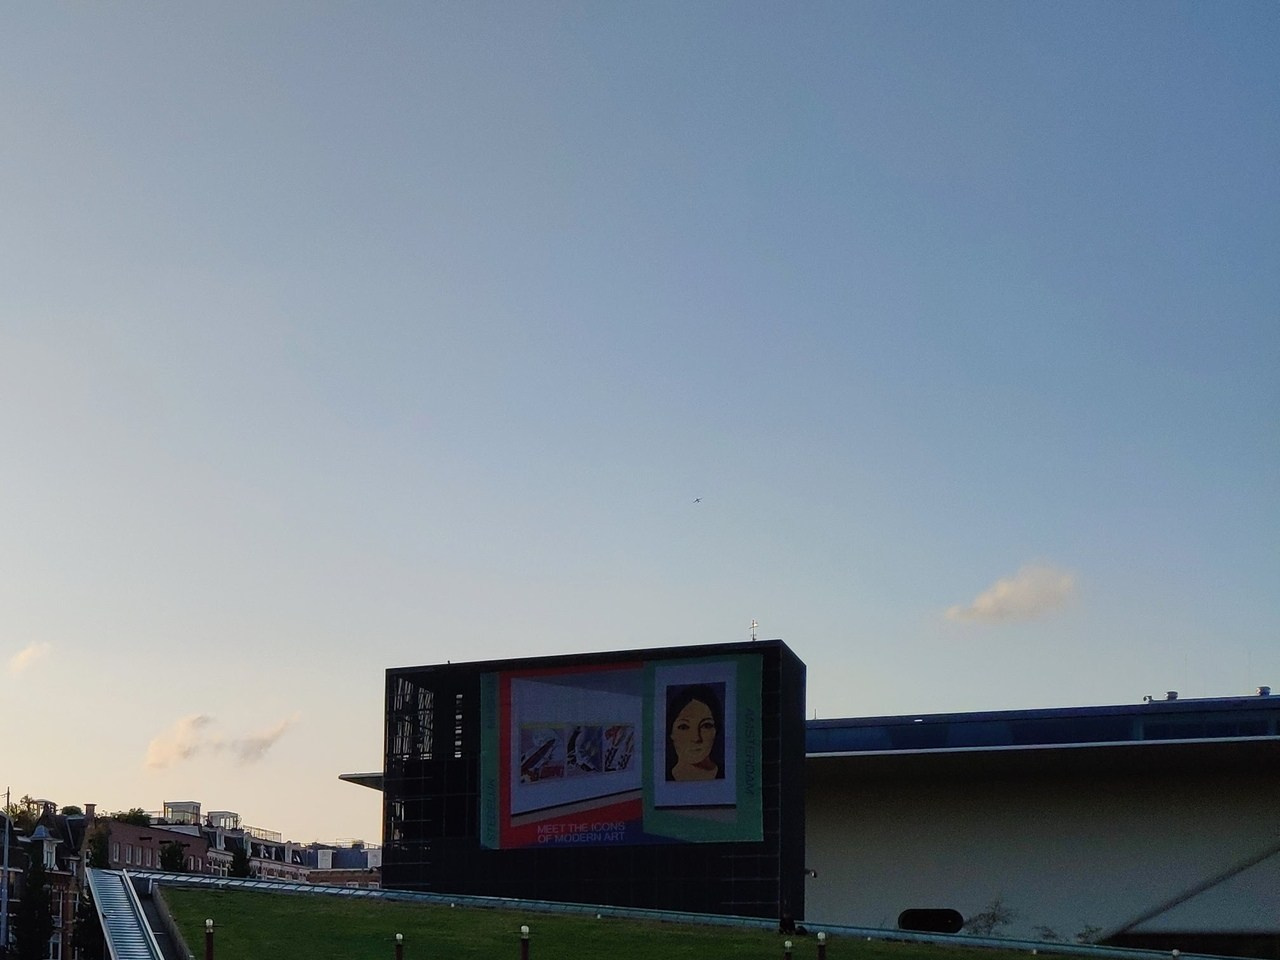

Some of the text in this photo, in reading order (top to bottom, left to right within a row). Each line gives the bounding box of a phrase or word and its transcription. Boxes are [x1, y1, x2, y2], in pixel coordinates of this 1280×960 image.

[744, 708, 755, 795] AMSTERDAM
[537, 821, 625, 834] MEET THE ICONS
[537, 832, 625, 843] OF MODERN ART
